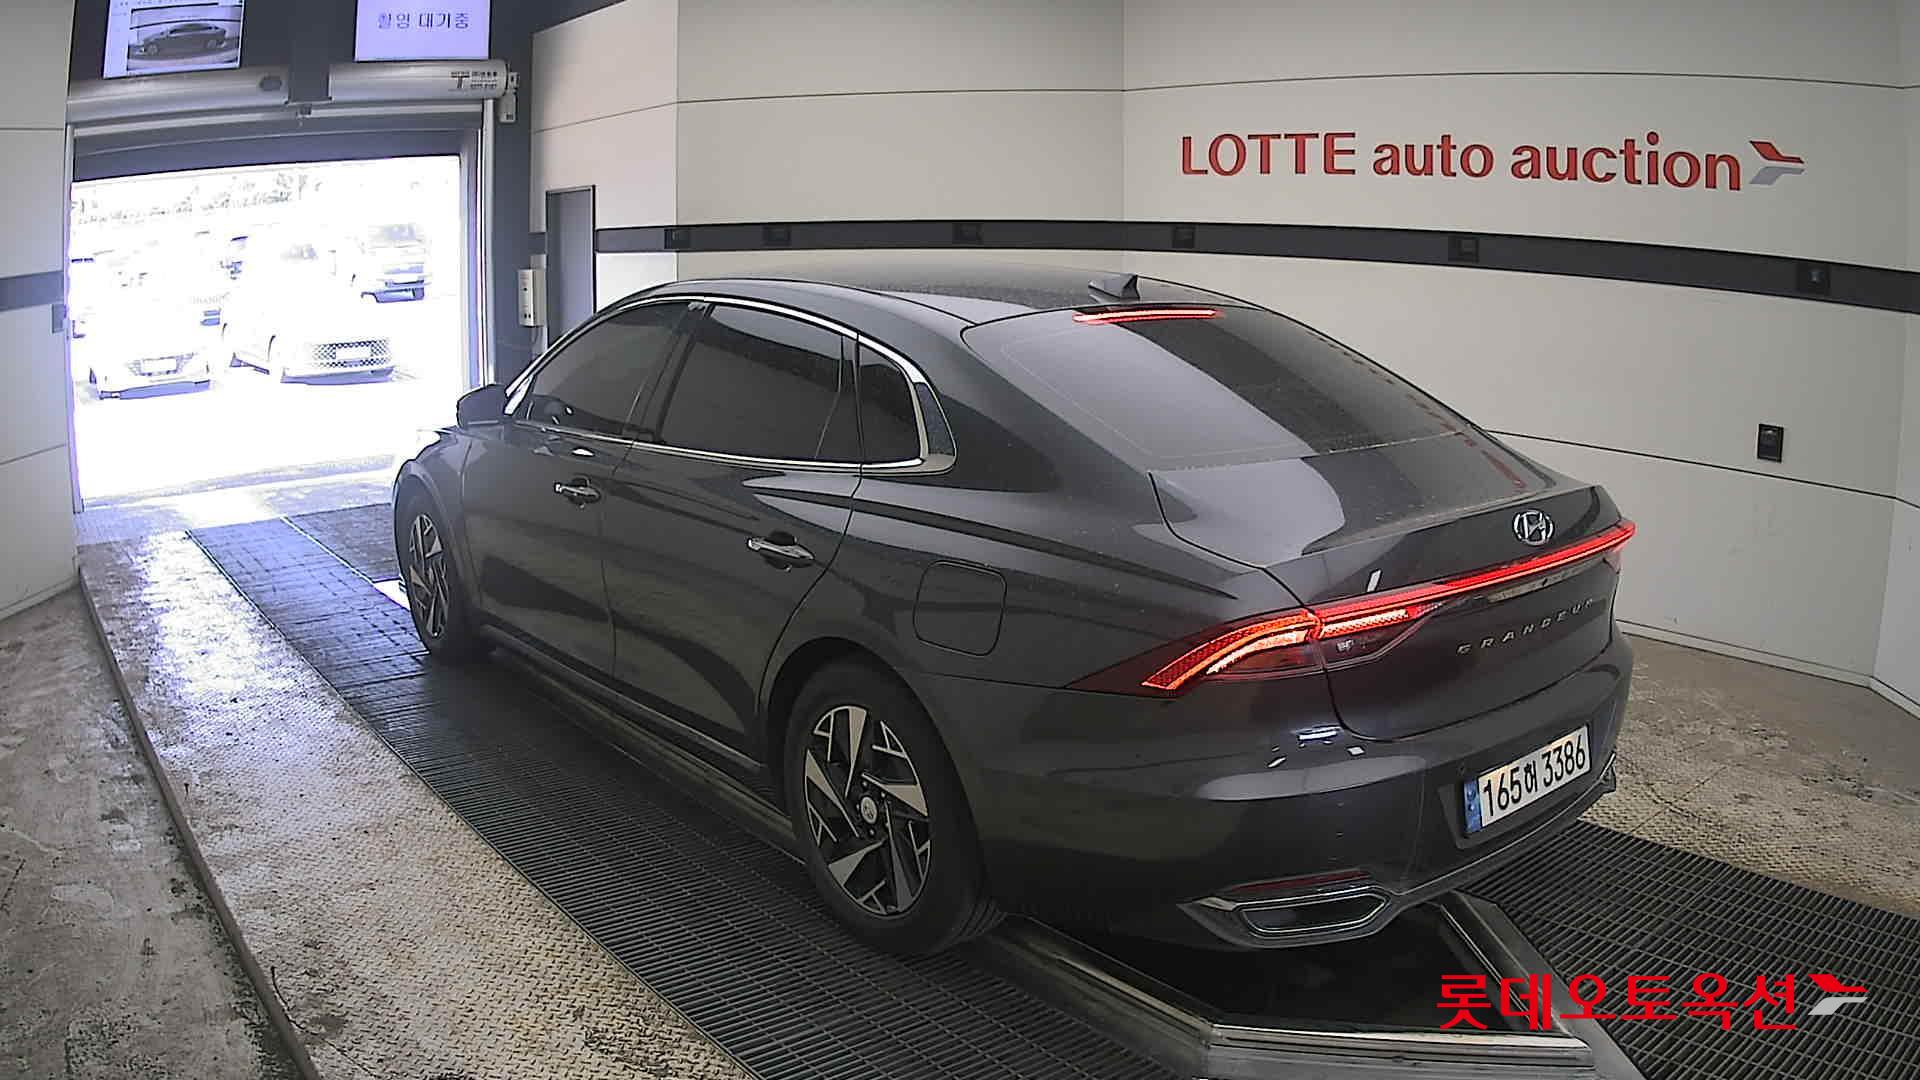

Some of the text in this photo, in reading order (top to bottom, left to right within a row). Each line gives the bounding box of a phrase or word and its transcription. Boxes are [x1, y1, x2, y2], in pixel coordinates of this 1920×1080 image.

[1182, 131, 1741, 191] LOTTE auto auction
[1456, 598, 1593, 655] GRANDEUR
[1483, 734, 1586, 816] 165허 3386
